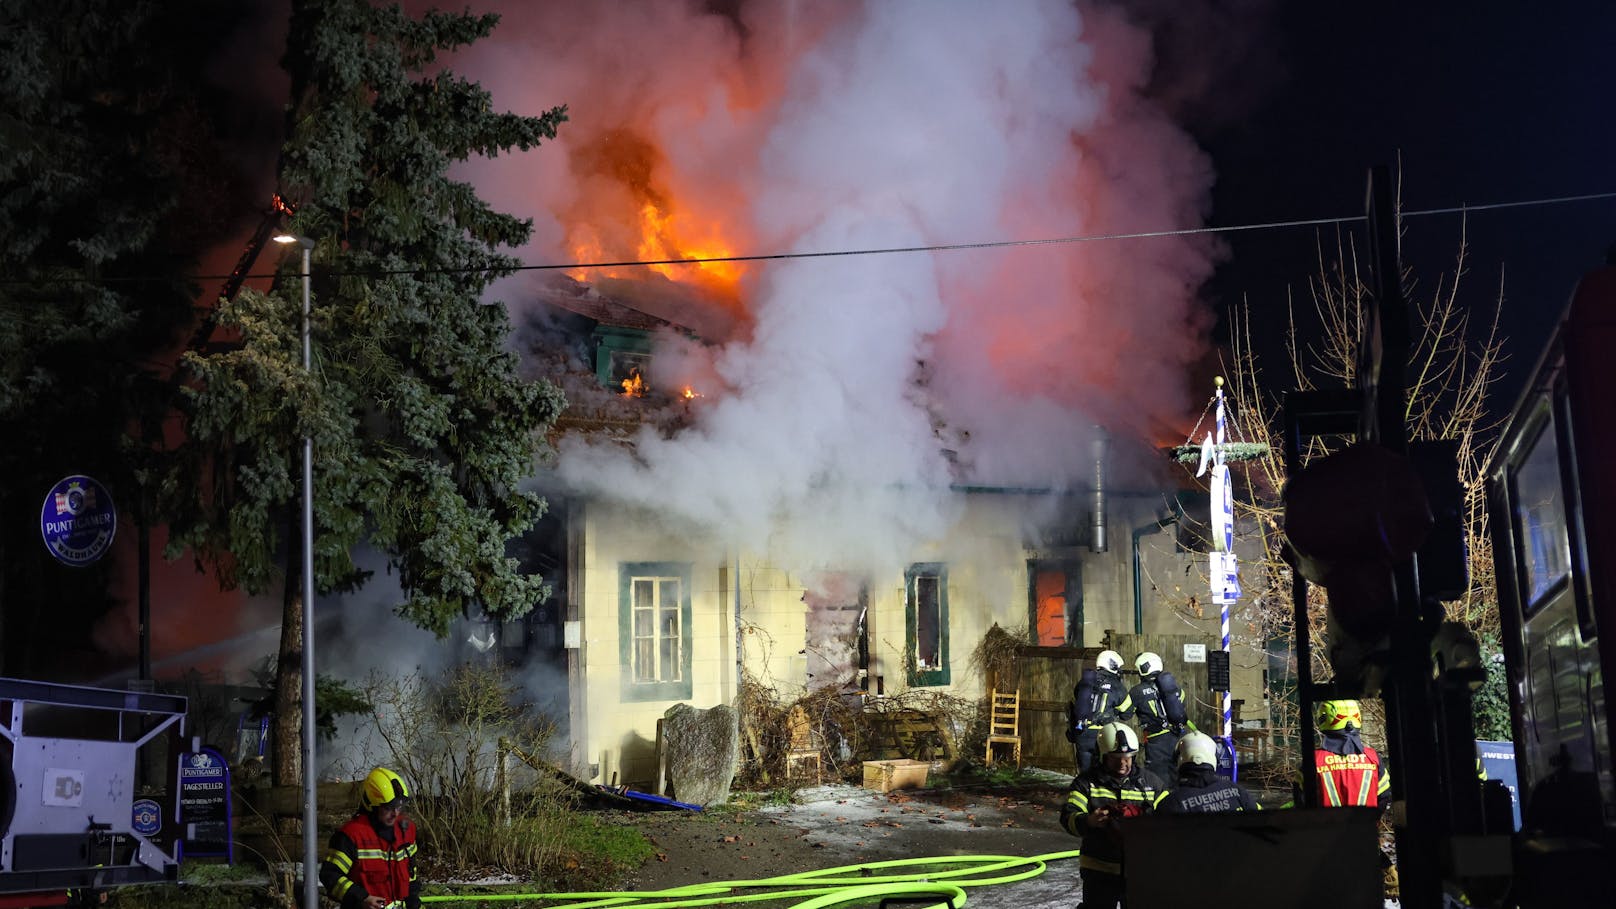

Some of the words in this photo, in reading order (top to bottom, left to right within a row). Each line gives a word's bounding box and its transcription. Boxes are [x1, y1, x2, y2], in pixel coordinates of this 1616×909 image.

[46, 513, 111, 535] PUNTIGAMER
[184, 768, 222, 776] PUNTIGAMER
[184, 783, 223, 791] TAGESTELLER
[1181, 787, 1240, 811] FEUERWEHR
[1202, 799, 1231, 812] ENNS
